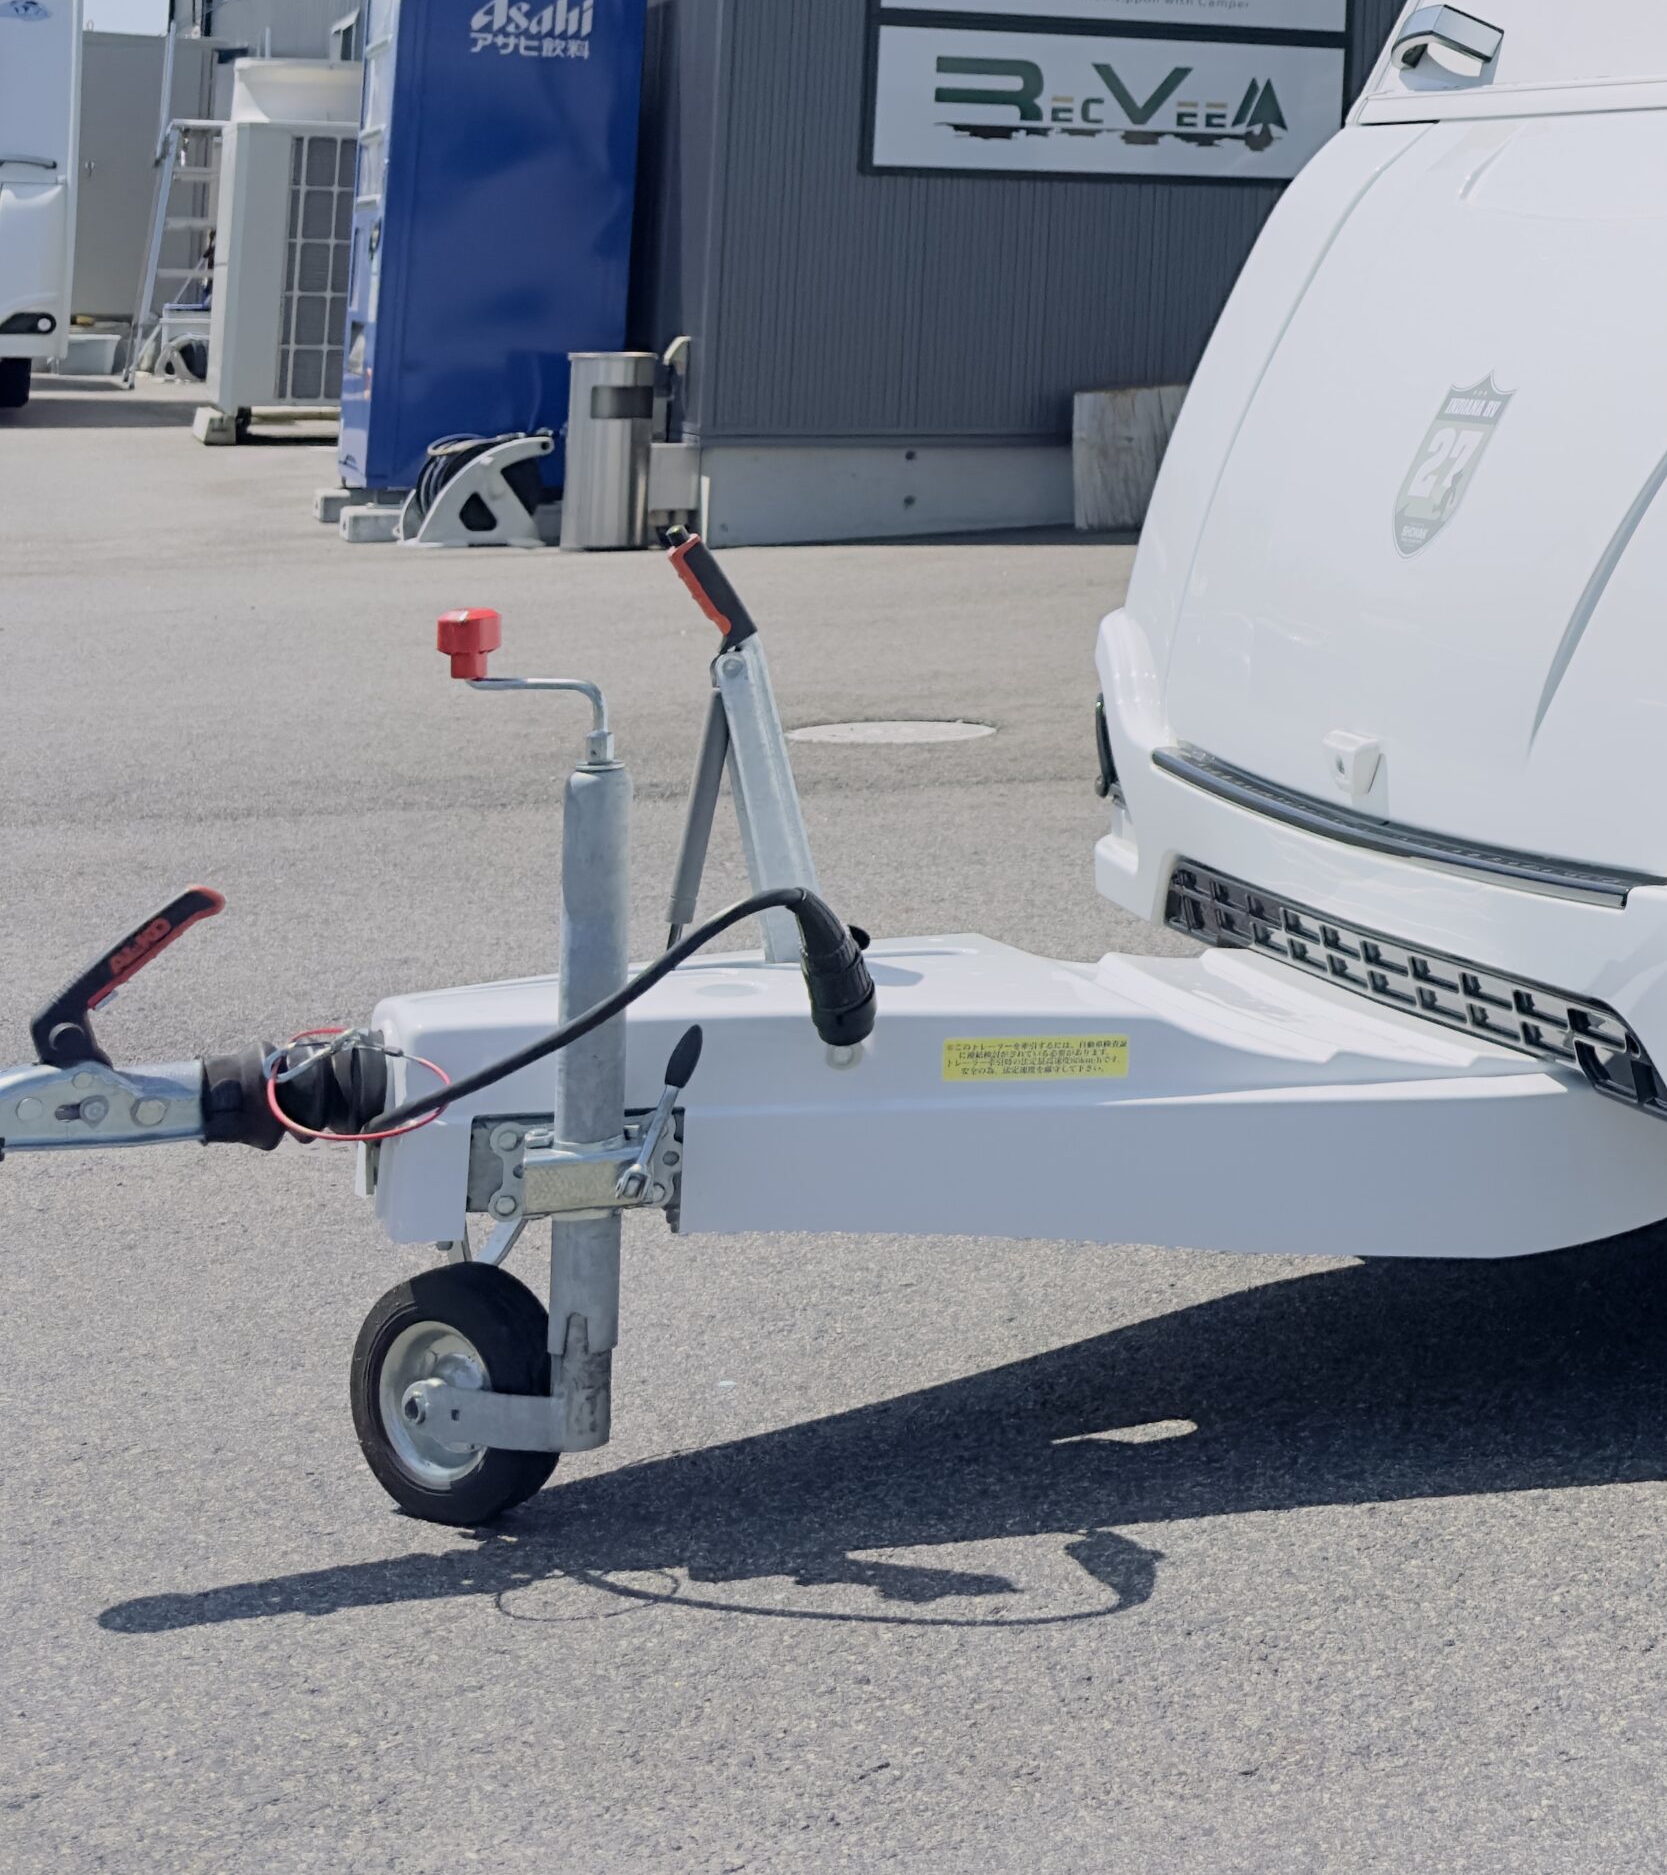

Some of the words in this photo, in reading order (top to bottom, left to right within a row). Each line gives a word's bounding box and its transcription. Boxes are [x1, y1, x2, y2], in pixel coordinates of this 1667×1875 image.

[469, 31, 589, 60] アサヒ飲料
[1407, 427, 1485, 498] 27
